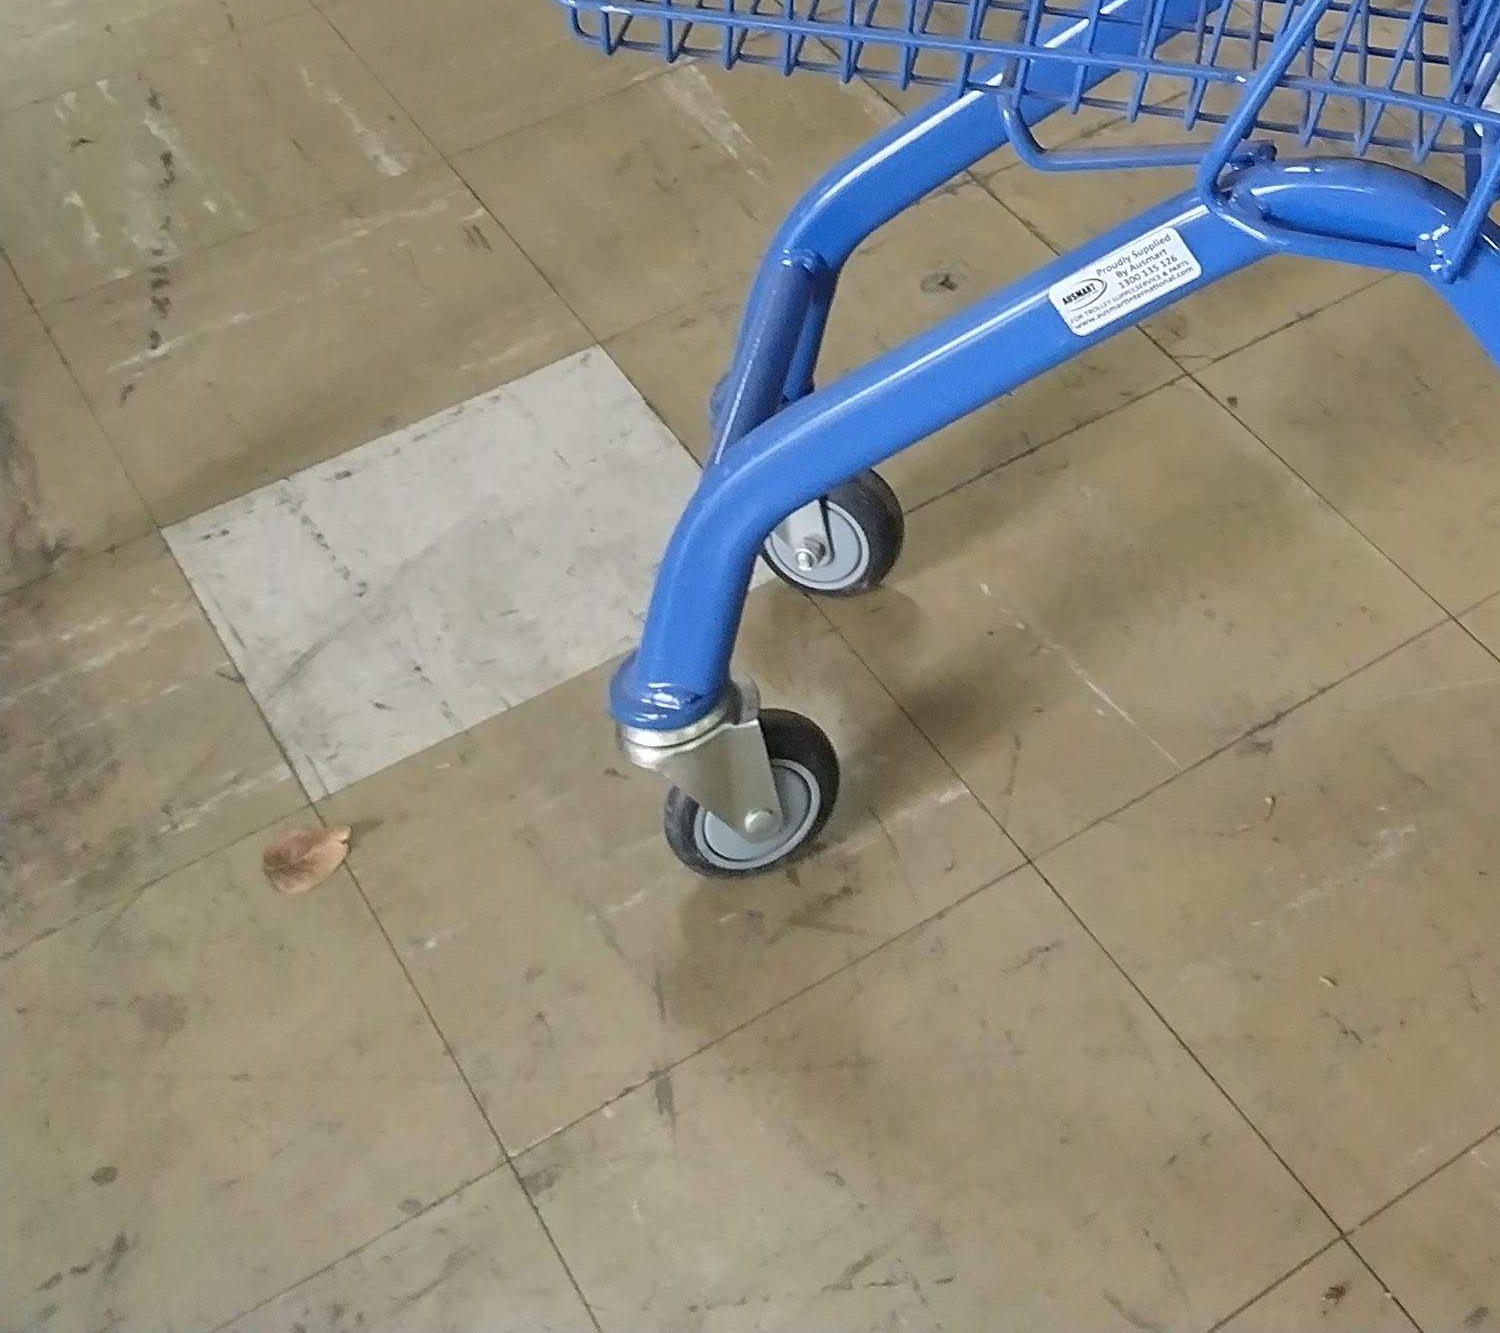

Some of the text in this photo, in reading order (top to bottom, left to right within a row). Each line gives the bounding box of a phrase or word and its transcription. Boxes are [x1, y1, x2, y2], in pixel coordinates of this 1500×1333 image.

[1096, 234, 1171, 276] Proudly Supplied
[1116, 249, 1168, 278] By Ausmart
[1118, 255, 1178, 289] 1300 135 126
[1062, 283, 1096, 305] AUSMART
